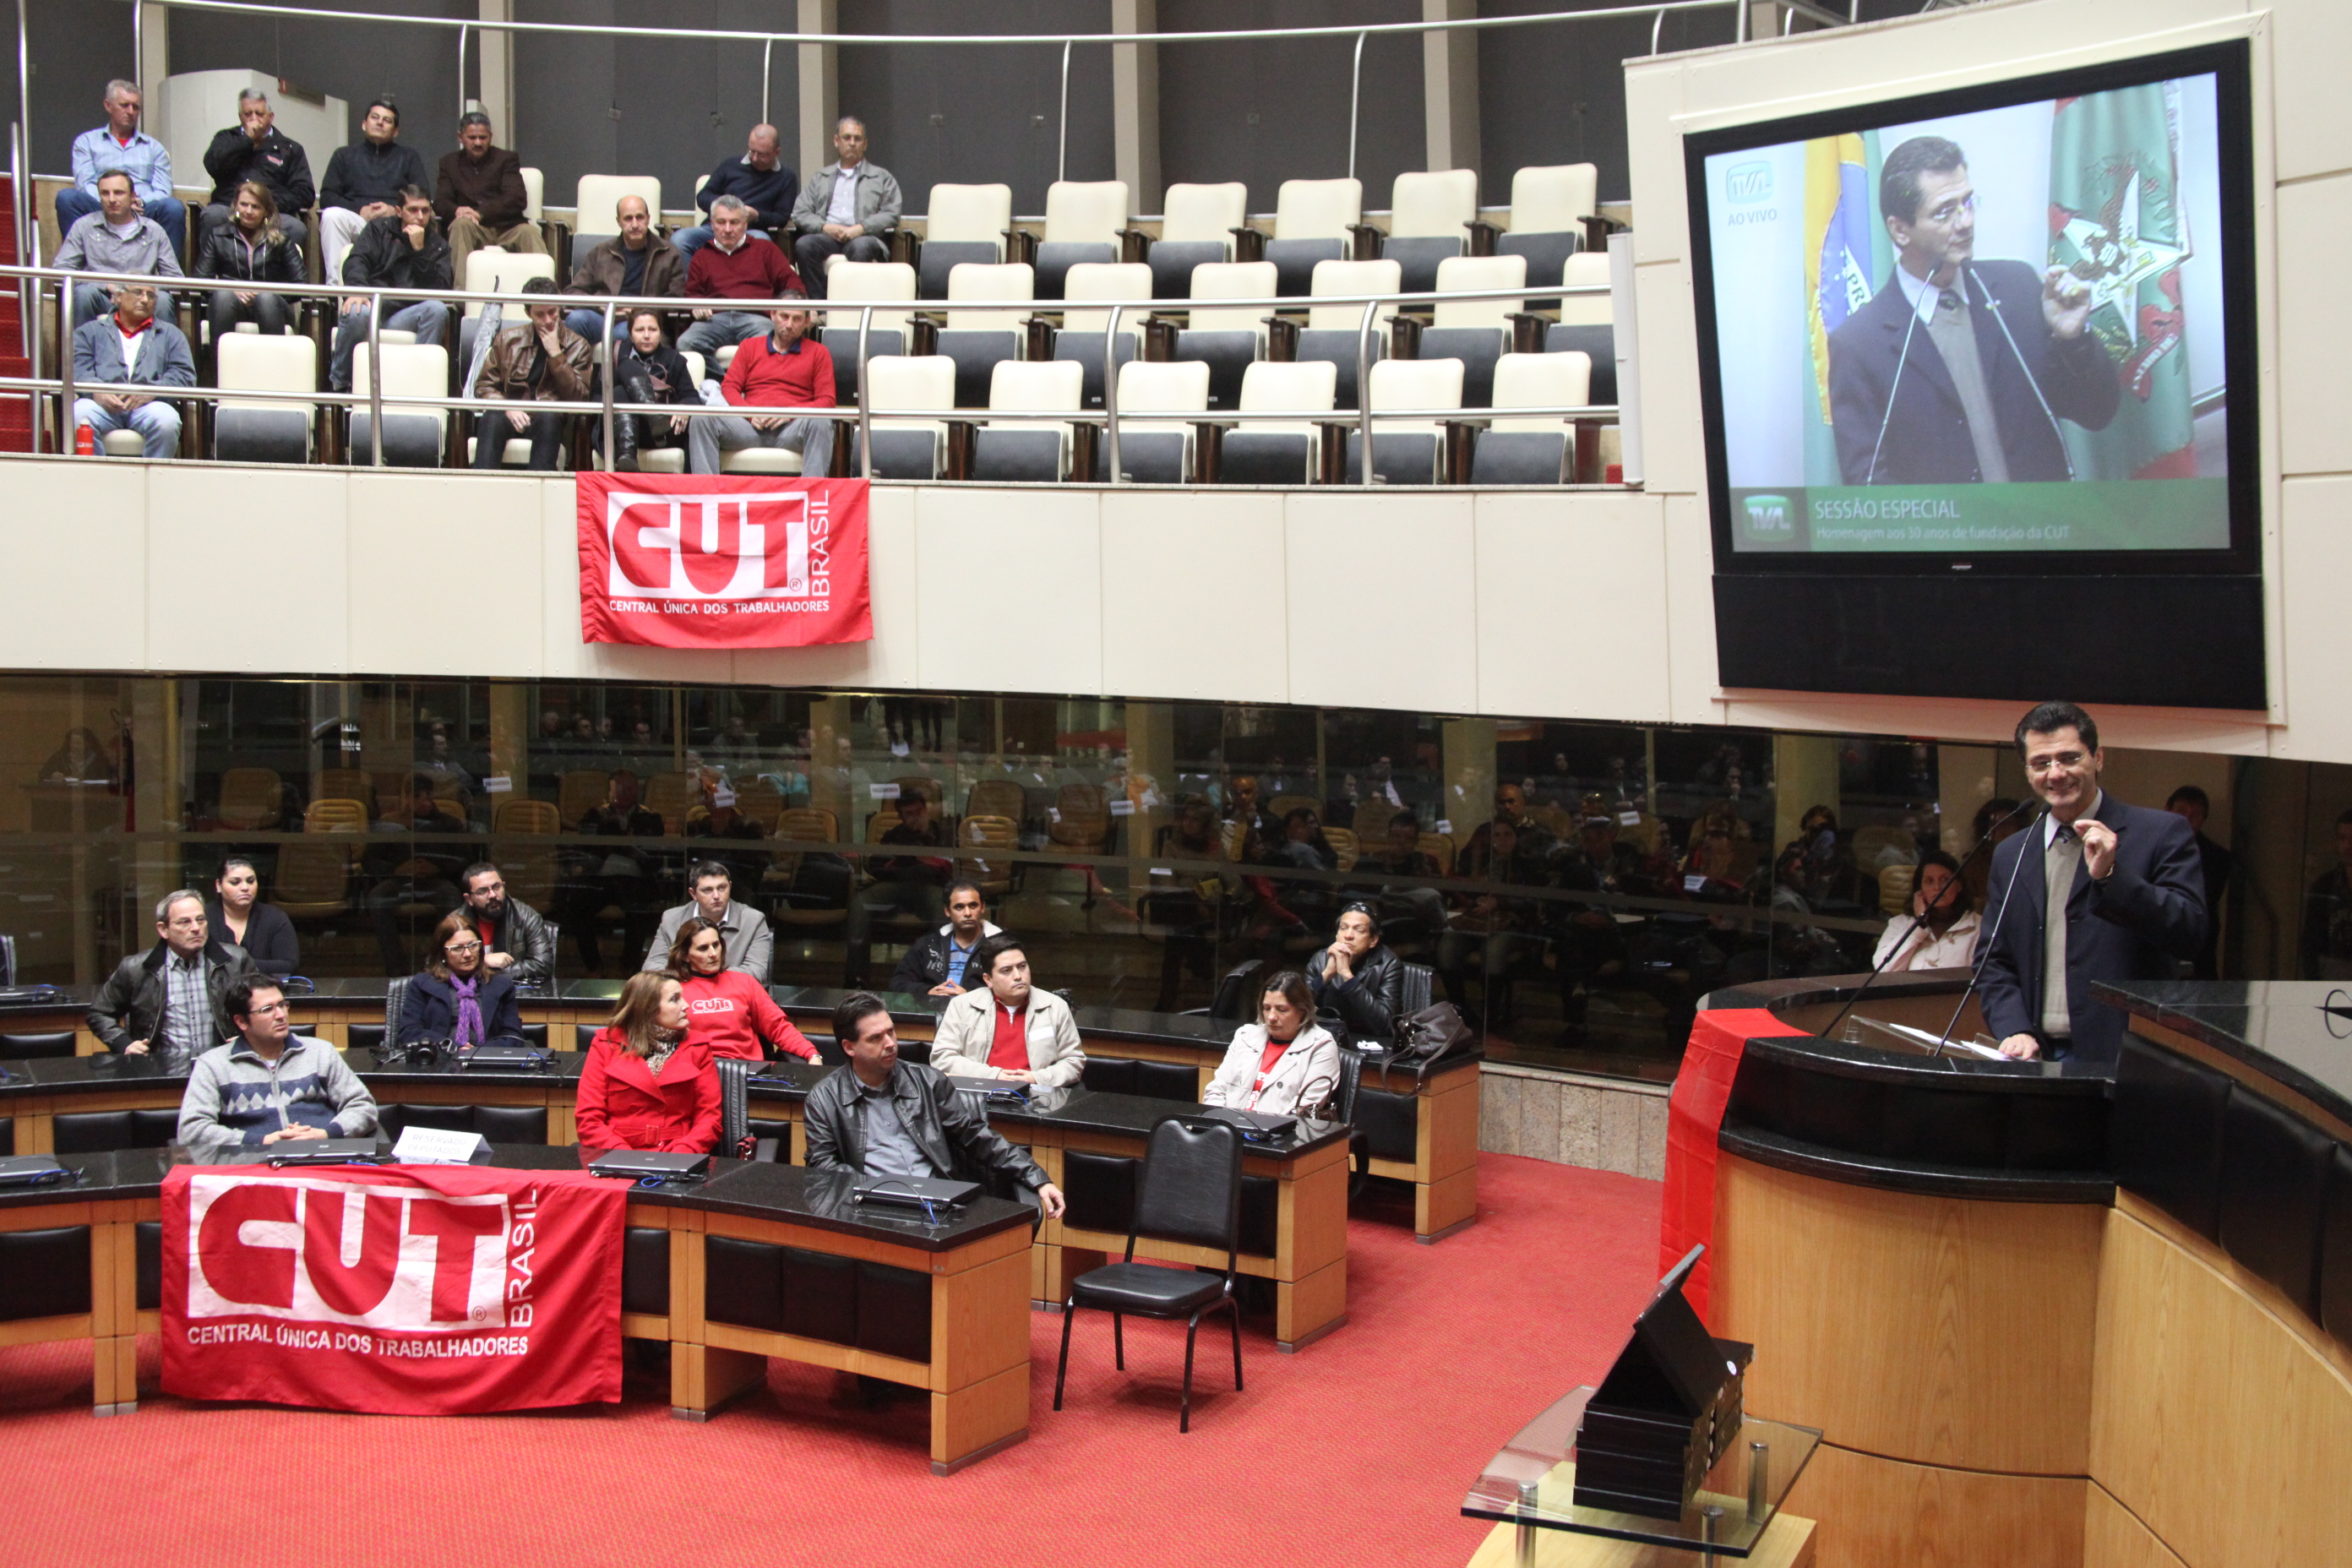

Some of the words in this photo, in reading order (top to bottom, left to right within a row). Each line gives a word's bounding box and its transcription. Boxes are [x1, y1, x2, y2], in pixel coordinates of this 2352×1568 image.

[1728, 213, 1745, 226] AO
[1747, 208, 1778, 224] VIVO
[1816, 498, 1877, 520] SESSÃO
[1881, 499, 1961, 519] ESPECIAL
[810, 489, 830, 596] BRASIL
[1817, 526, 1884, 542] Homenagem
[1886, 529, 1905, 539] aos
[1908, 526, 1922, 539] 30
[1924, 529, 1949, 539] anos
[1952, 525, 1968, 539] de
[1969, 525, 2023, 542] fundação
[2027, 525, 2042, 539] da
[2044, 525, 2070, 539] CUT
[612, 499, 803, 595] CUT
[609, 599, 659, 614] CENTRAL
[663, 598, 698, 614] ÚNICA
[704, 603, 728, 614] DOS
[734, 600, 830, 613] TRABALHADORES
[692, 999, 726, 1011] CUT
[407, 1144, 461, 1155] DEPUTADOS
[412, 1134, 467, 1146] RESERVADO
[198, 1183, 504, 1323] CUT
[508, 1188, 539, 1328] BRASIL
[187, 1324, 274, 1346] CENTRAL
[276, 1325, 331, 1349] ÚNICA
[335, 1333, 372, 1354] DOS
[377, 1335, 529, 1358] TRABALHADORES
